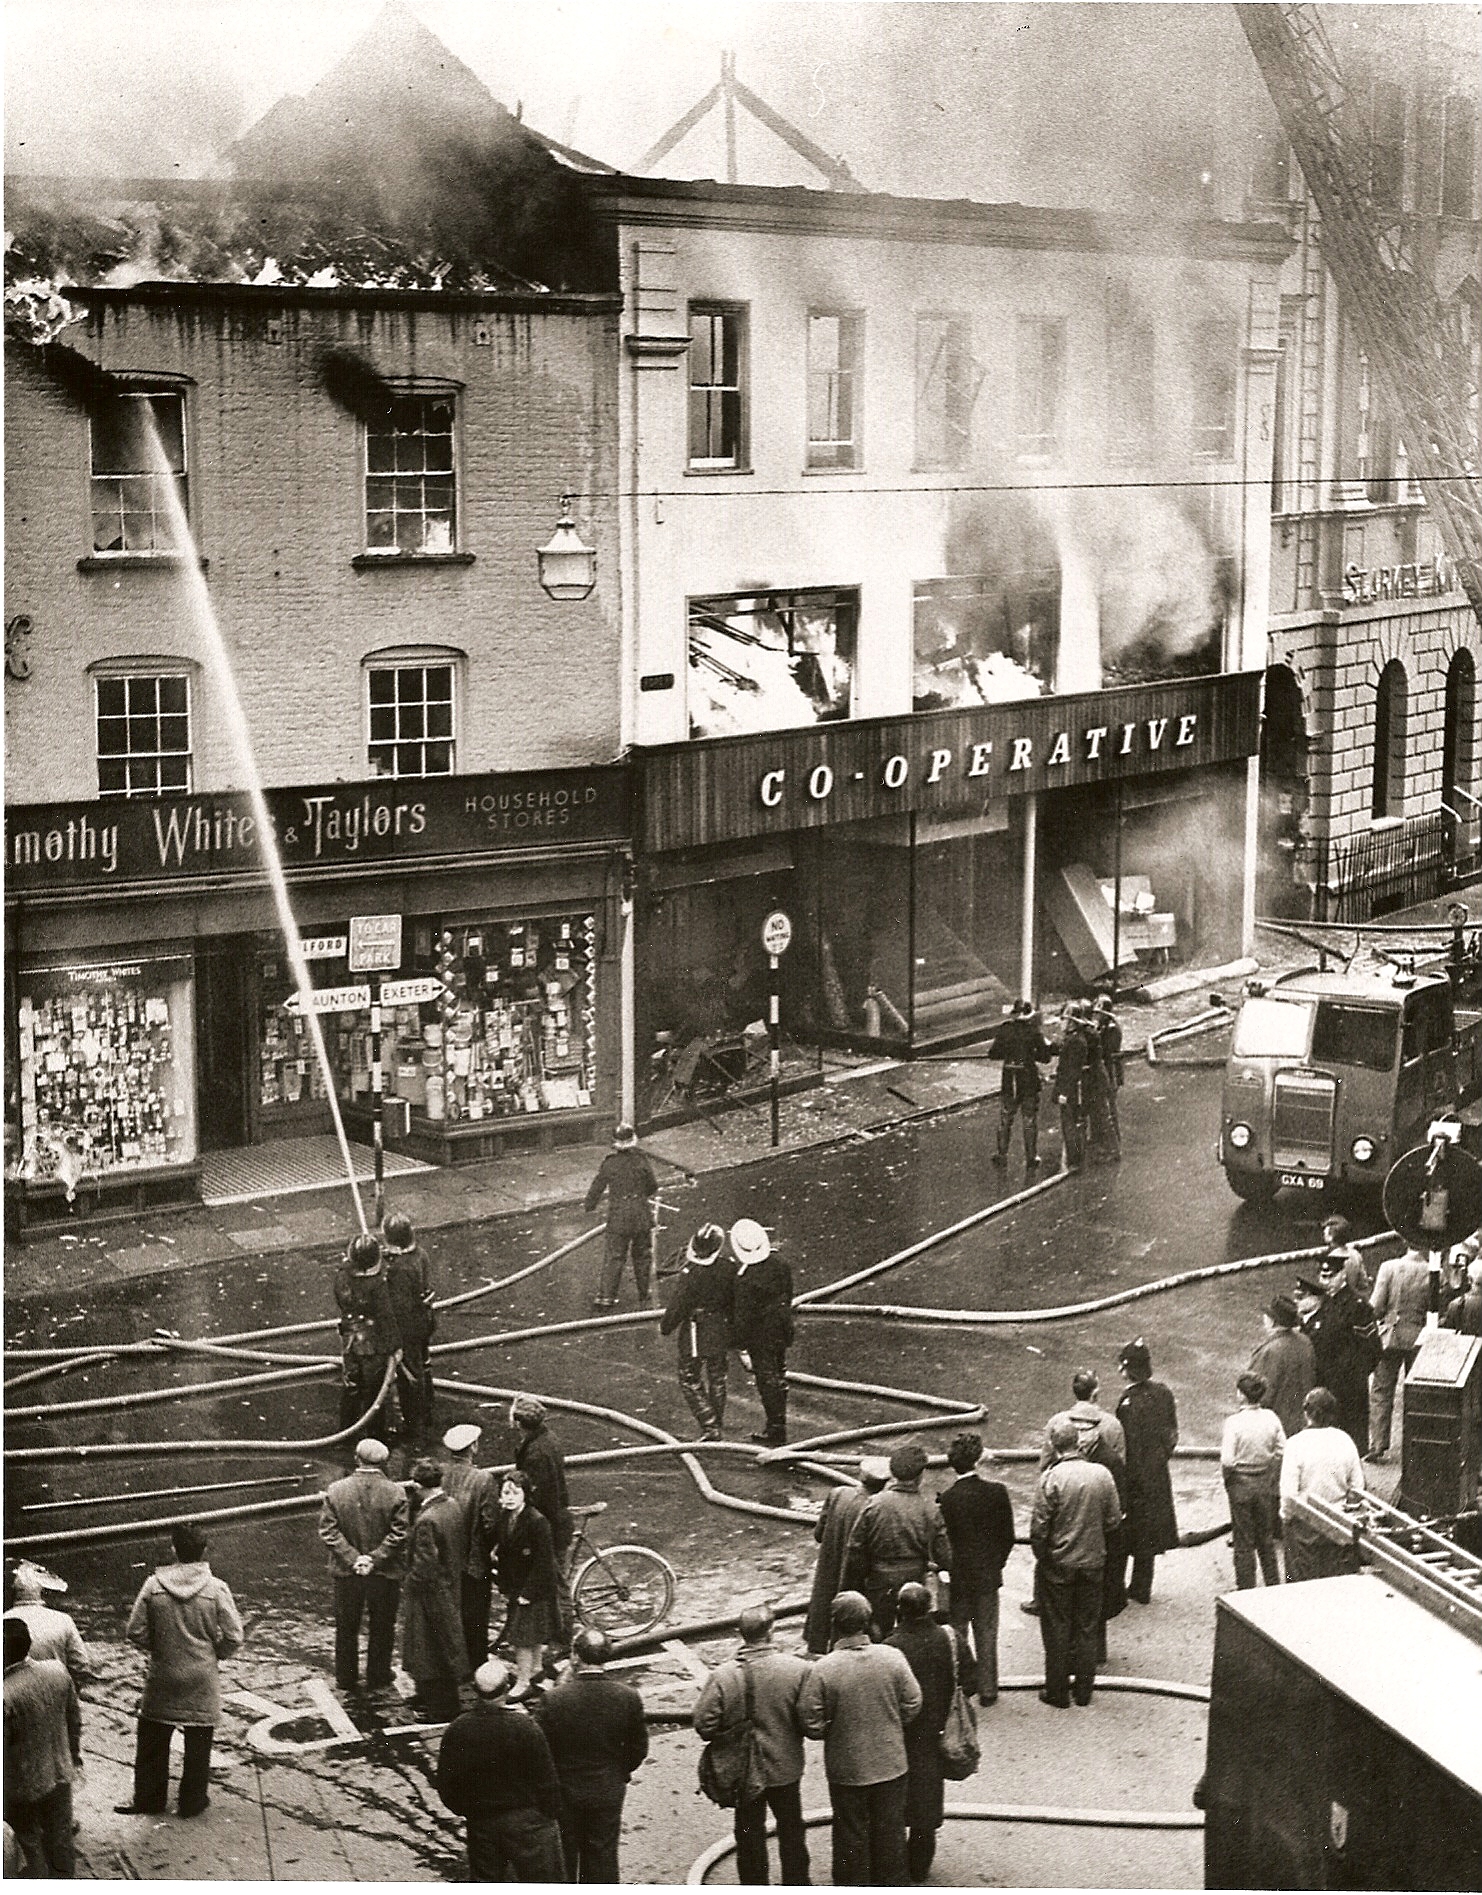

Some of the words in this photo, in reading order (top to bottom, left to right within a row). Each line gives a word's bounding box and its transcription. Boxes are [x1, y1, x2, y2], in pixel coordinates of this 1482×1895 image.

[761, 715, 1197, 806] CO-OPERATIVE
[465, 787, 597, 813] HOUSEHOLD
[285, 827, 298, 843] &
[303, 795, 427, 857] Taylors
[488, 808, 568, 829] STORES
[771, 919, 784, 931] NO
[312, 992, 367, 1006] AUNTON
[384, 984, 429, 1000] EXETER
